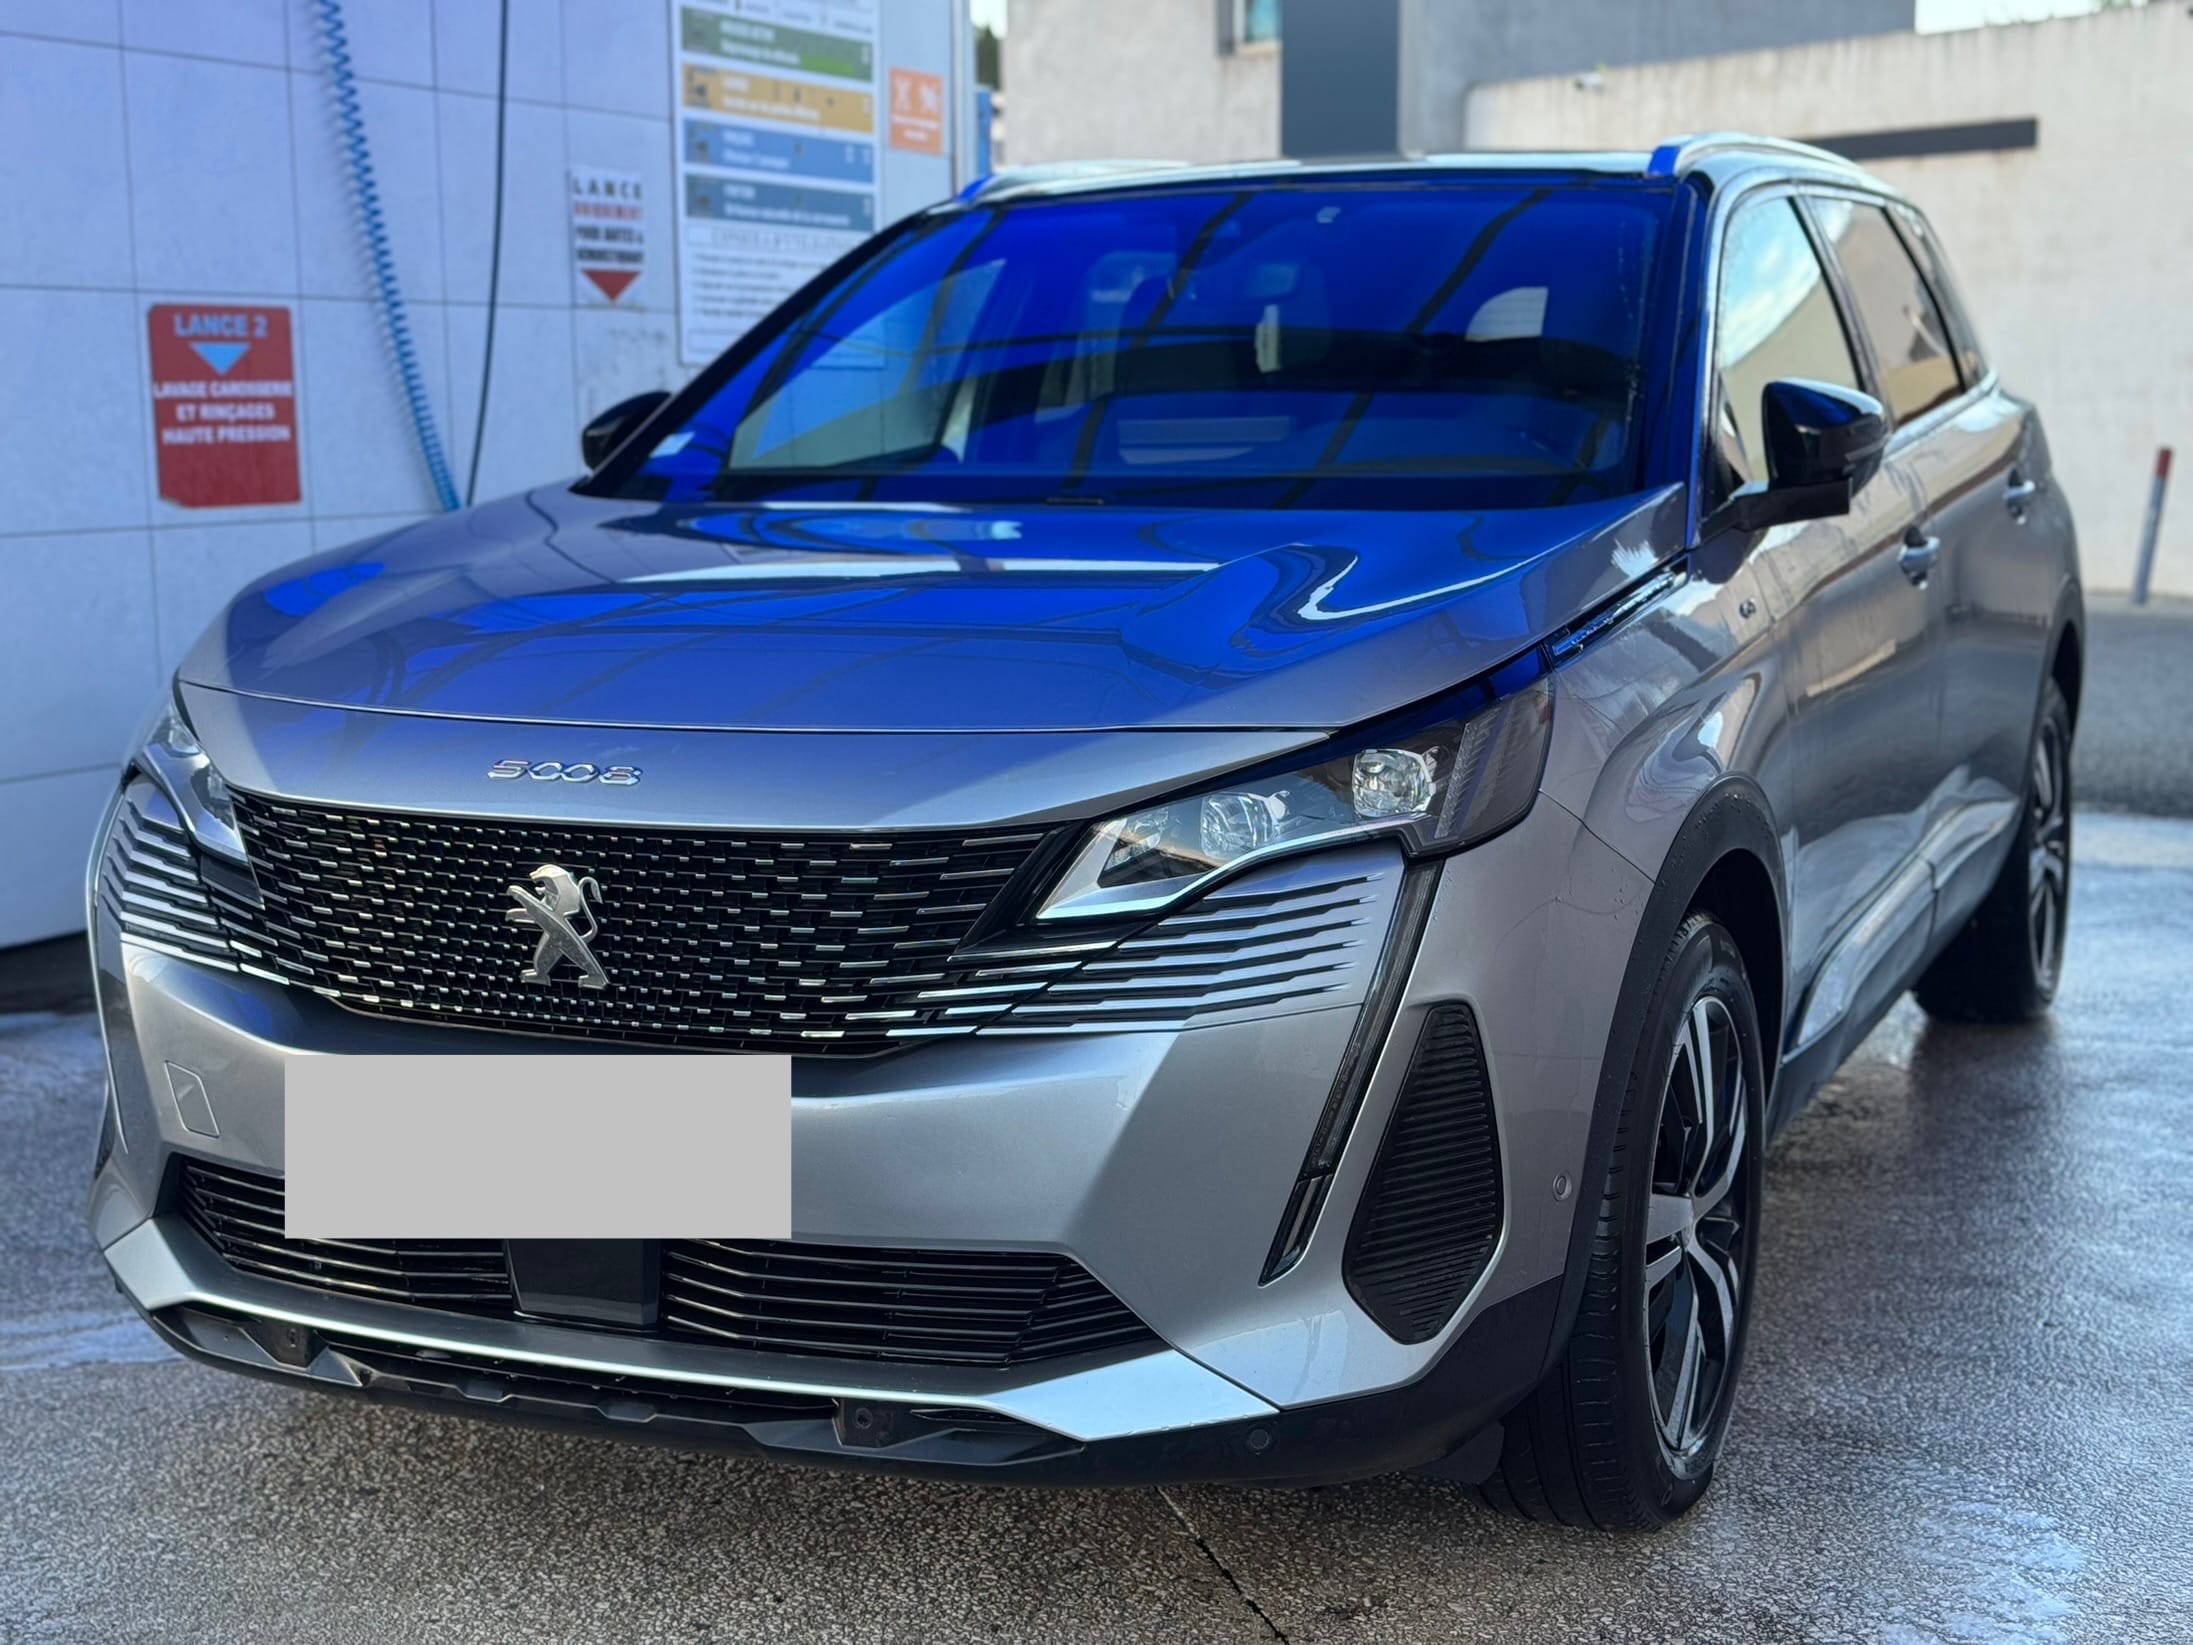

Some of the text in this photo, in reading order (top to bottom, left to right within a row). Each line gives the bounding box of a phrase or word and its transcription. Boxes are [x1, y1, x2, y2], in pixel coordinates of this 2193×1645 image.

[174, 313, 268, 339] LANCE 2
[154, 381, 207, 399] LAVAGE
[176, 403, 197, 422] ET
[162, 425, 292, 445] HAUTE PRESSION
[487, 759, 643, 786] 5008
